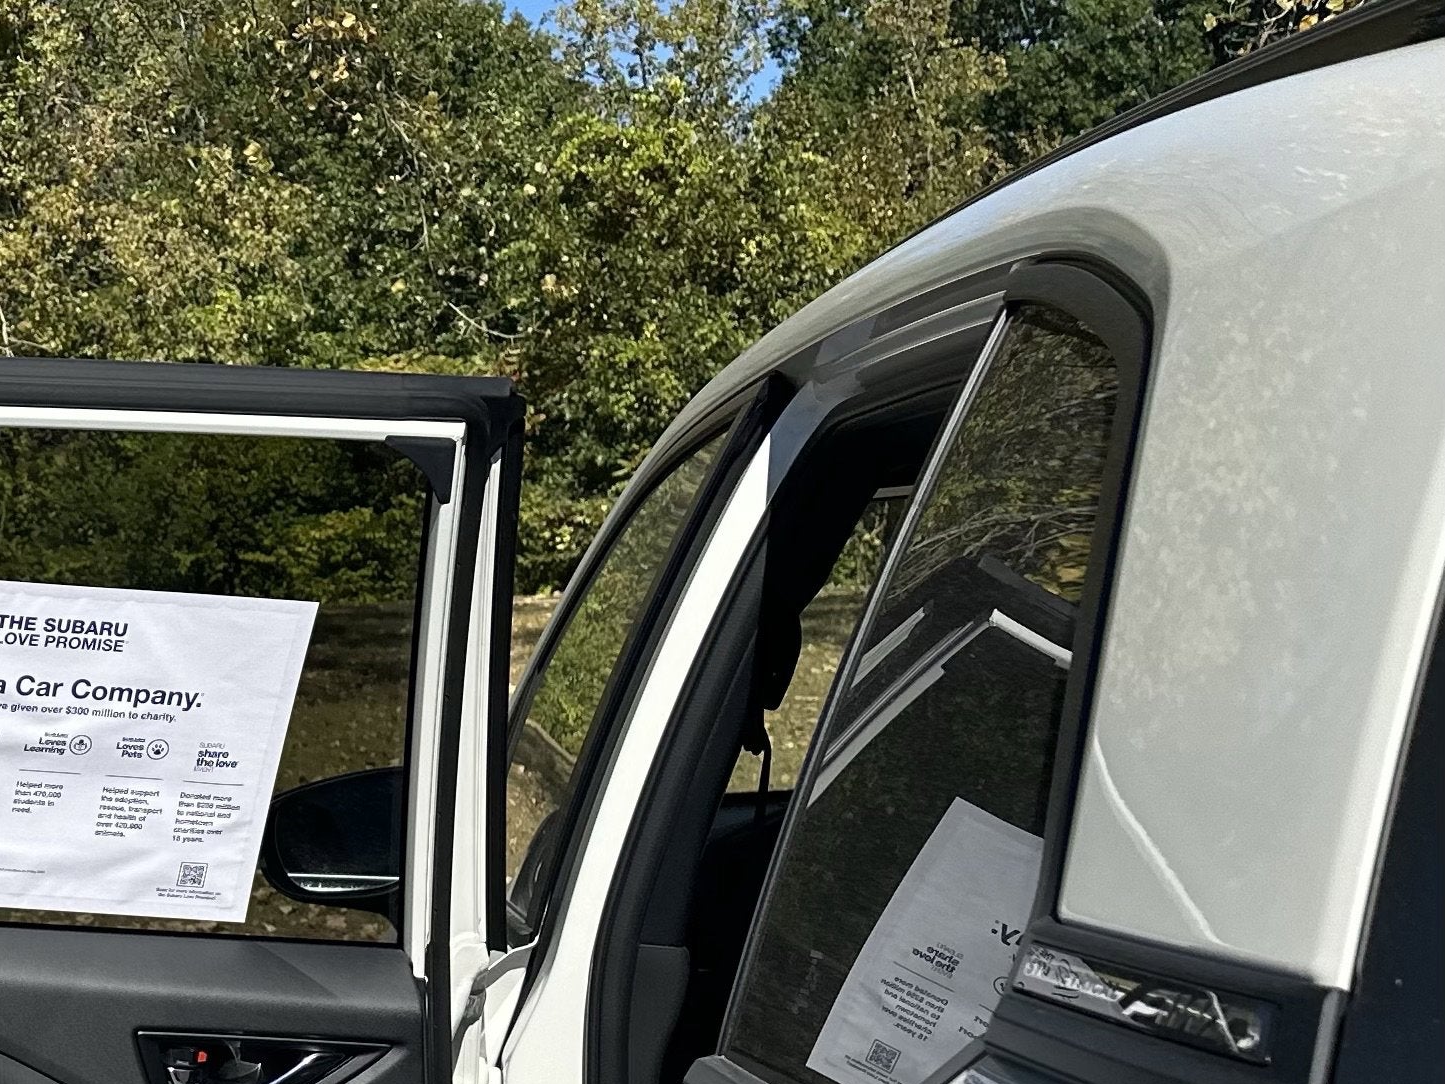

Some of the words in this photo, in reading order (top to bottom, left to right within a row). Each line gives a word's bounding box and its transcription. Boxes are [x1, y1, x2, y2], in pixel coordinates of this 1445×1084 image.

[43, 618, 127, 636] SUBARU
[44, 635, 124, 652] PROMISE
[15, 675, 63, 696] Car
[10, 703, 38, 712] given
[65, 705, 89, 715] $300
[91, 708, 125, 718] million
[128, 710, 138, 719] to
[140, 711, 177, 723] charity.
[38, 737, 66, 746] Loves
[116, 741, 144, 750] Loves
[23, 743, 66, 755] Learning
[121, 749, 142, 758] Pets
[197, 749, 228, 758] share
[196, 757, 214, 767] the
[215, 758, 237, 768] love
